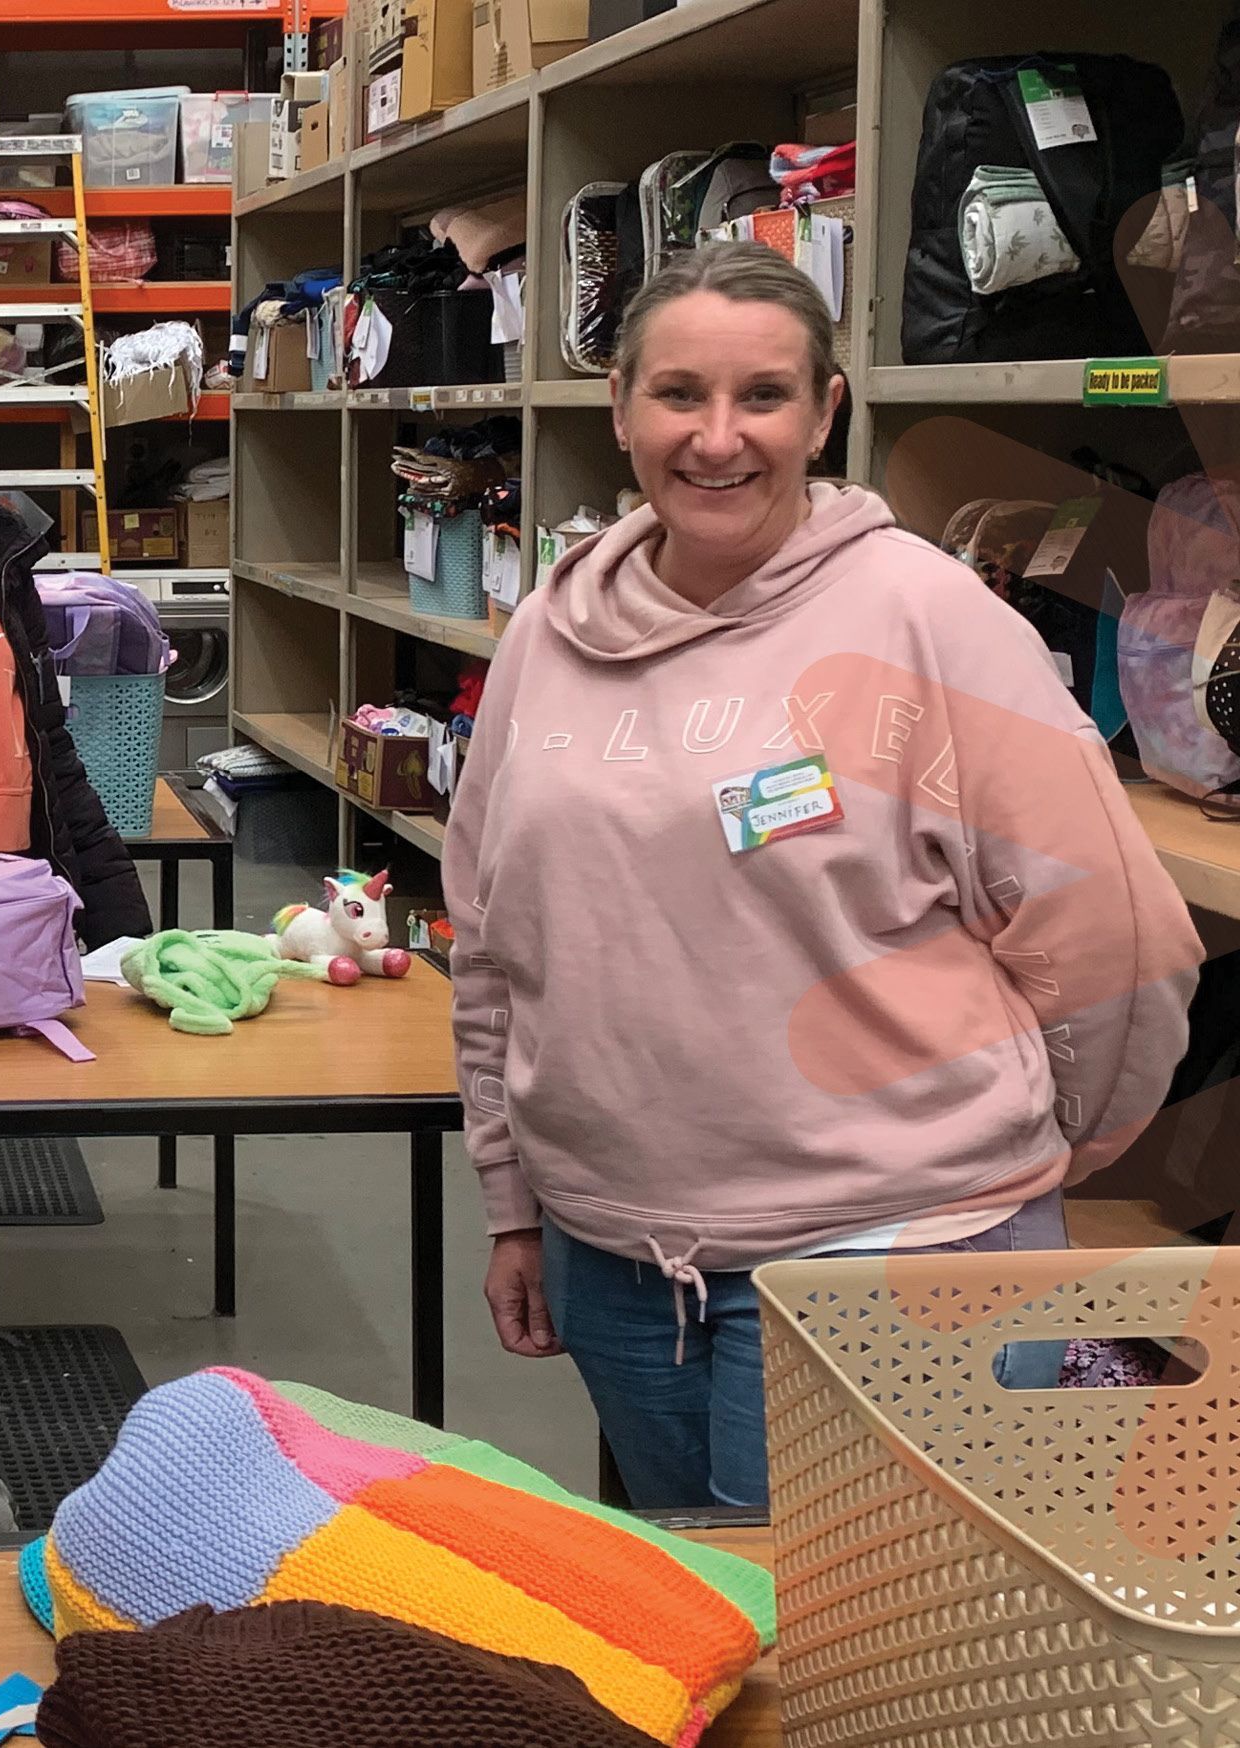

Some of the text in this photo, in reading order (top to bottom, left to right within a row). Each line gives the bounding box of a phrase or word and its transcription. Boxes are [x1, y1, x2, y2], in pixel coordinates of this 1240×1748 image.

[1088, 371, 1110, 392] Ready
[1120, 371, 1130, 389] be
[1130, 371, 1159, 392] packed
[751, 800, 824, 827] JENNIFER
